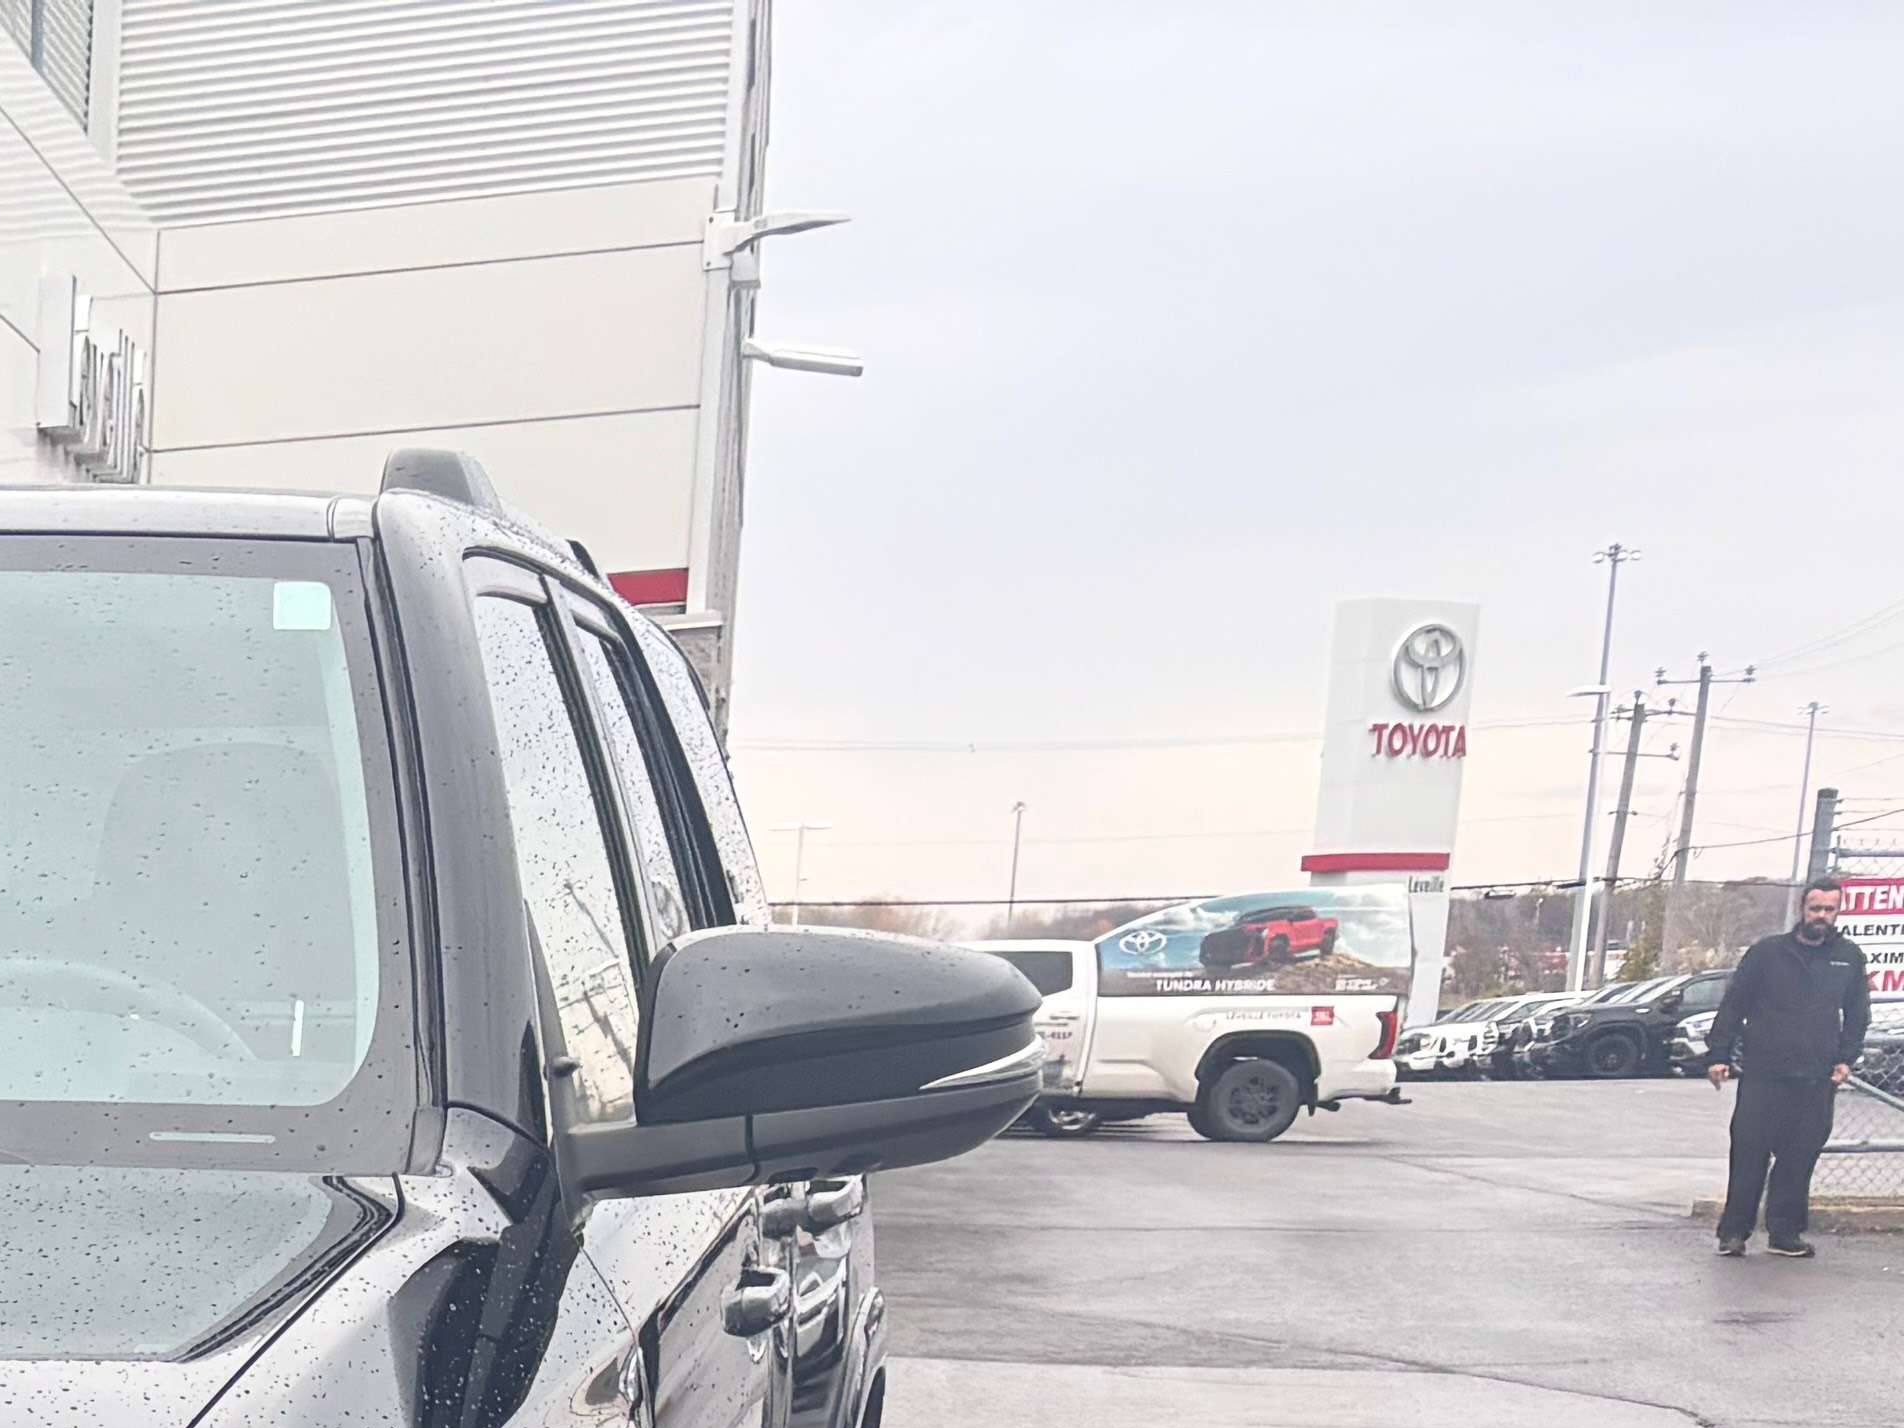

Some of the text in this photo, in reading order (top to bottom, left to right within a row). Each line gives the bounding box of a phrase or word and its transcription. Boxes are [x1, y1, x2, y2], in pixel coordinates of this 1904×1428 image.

[1371, 722, 1467, 758] TOYOTA
[1155, 978, 1276, 992] TUNDRA HYBRIDE
